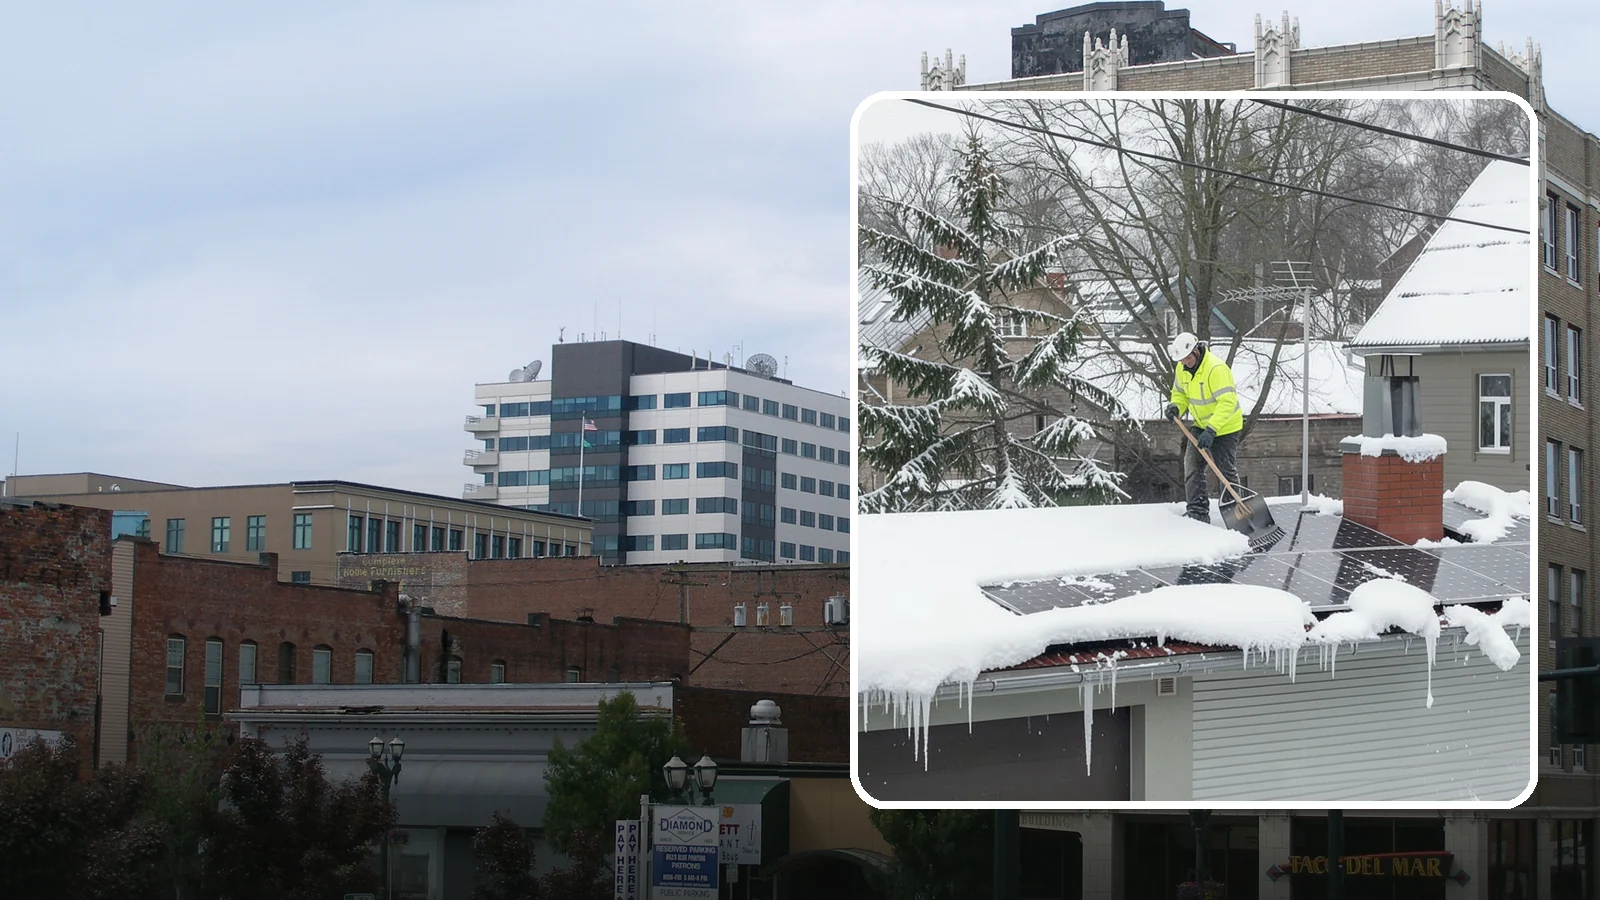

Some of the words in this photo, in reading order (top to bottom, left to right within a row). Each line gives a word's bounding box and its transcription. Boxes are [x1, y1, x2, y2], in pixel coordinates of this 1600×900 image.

[343, 567, 368, 577] Home
[370, 566, 427, 576] Furnishers
[660, 818, 713, 833] DIAMOND
[1022, 815, 1069, 828] BUILDING
[617, 825, 625, 852] PAY
[628, 824, 637, 852] PAY
[656, 845, 688, 853] RESERVED
[689, 846, 716, 854] PARKING
[722, 852, 739, 862] Soup
[671, 862, 701, 870] PATRONS
[1290, 855, 1329, 874] TAC
[1346, 856, 1385, 875] DEL
[1392, 857, 1443, 876] MAR
[616, 856, 625, 893] HERE
[627, 855, 636, 893] HERE
[660, 888, 682, 897] PUBLIC
[683, 889, 710, 898] PARKING
